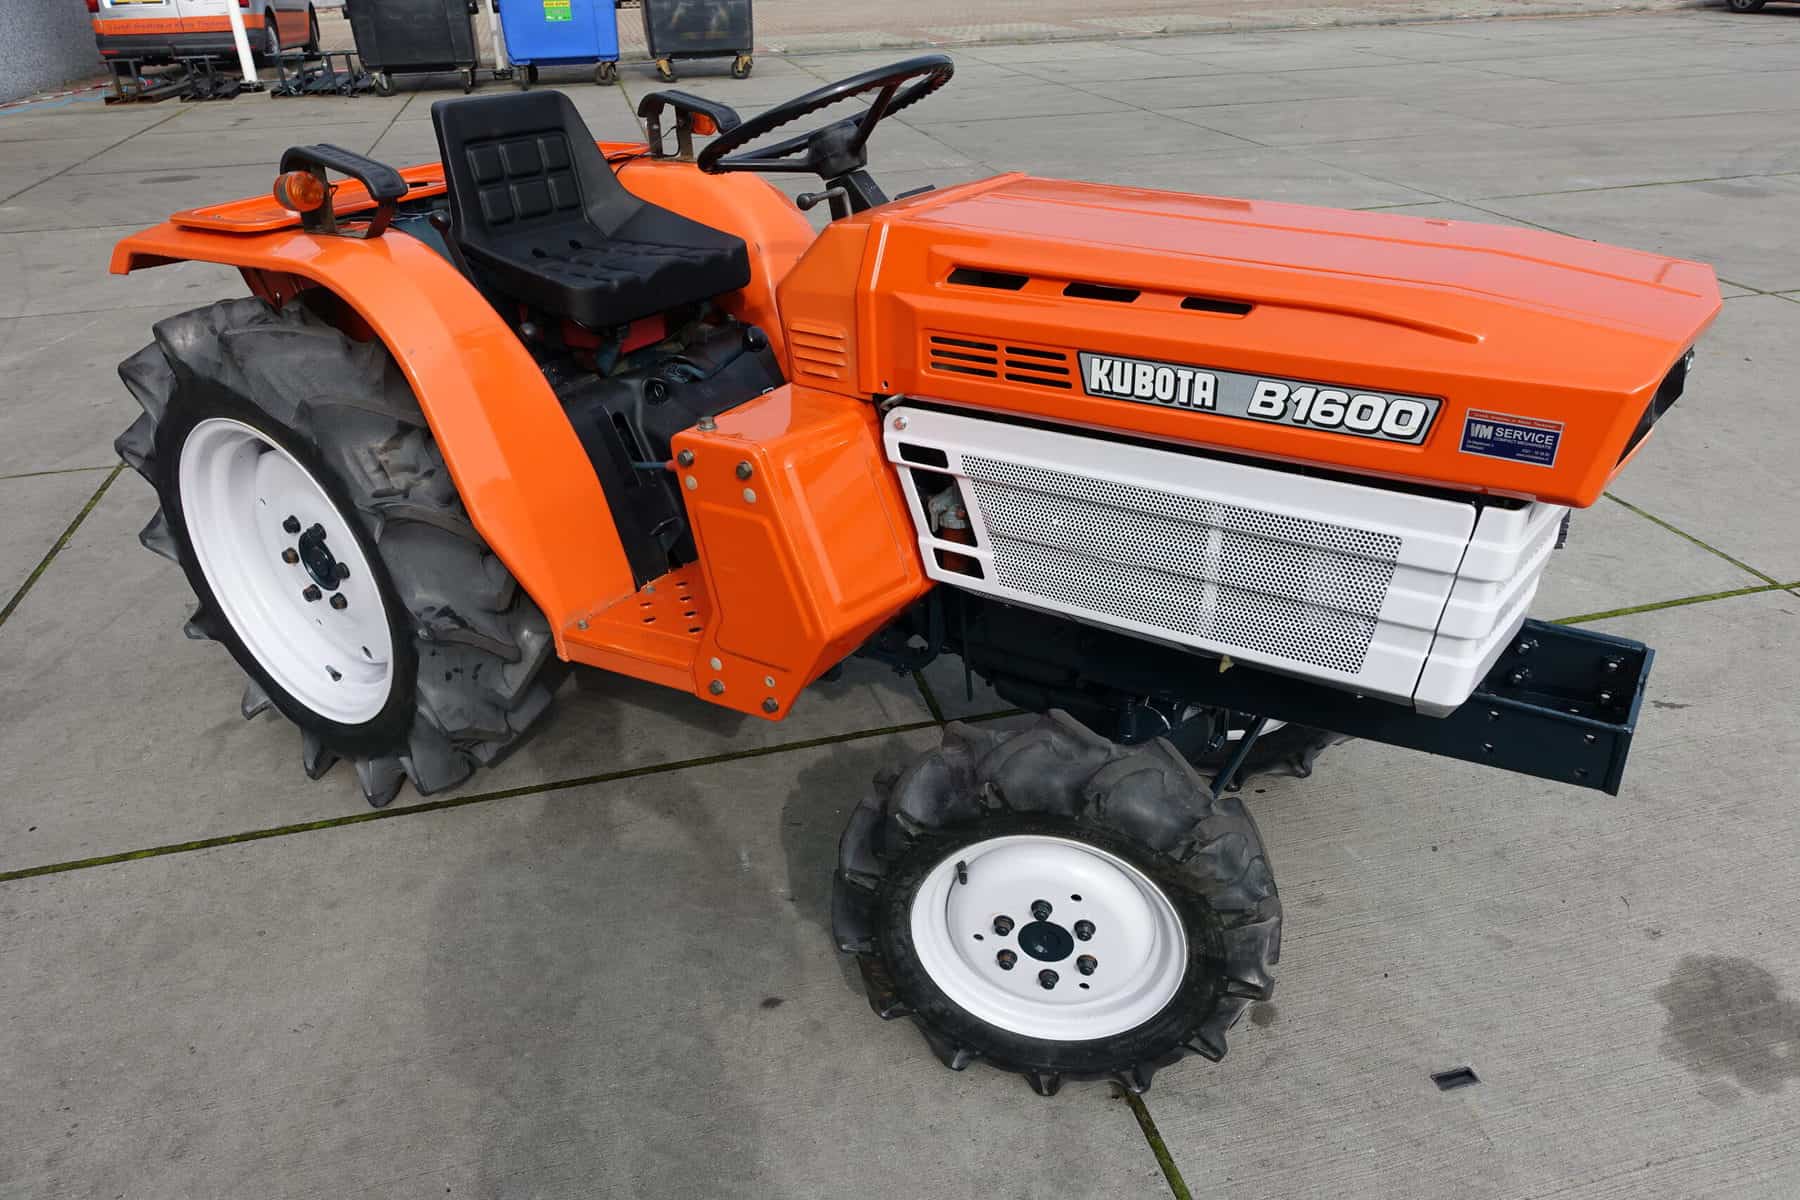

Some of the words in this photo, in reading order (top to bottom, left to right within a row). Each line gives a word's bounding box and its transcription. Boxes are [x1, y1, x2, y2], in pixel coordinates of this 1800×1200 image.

[1090, 357, 1217, 408] KUBOTA
[1248, 380, 1428, 438] B1600
[1495, 427, 1555, 445] SERVICE
